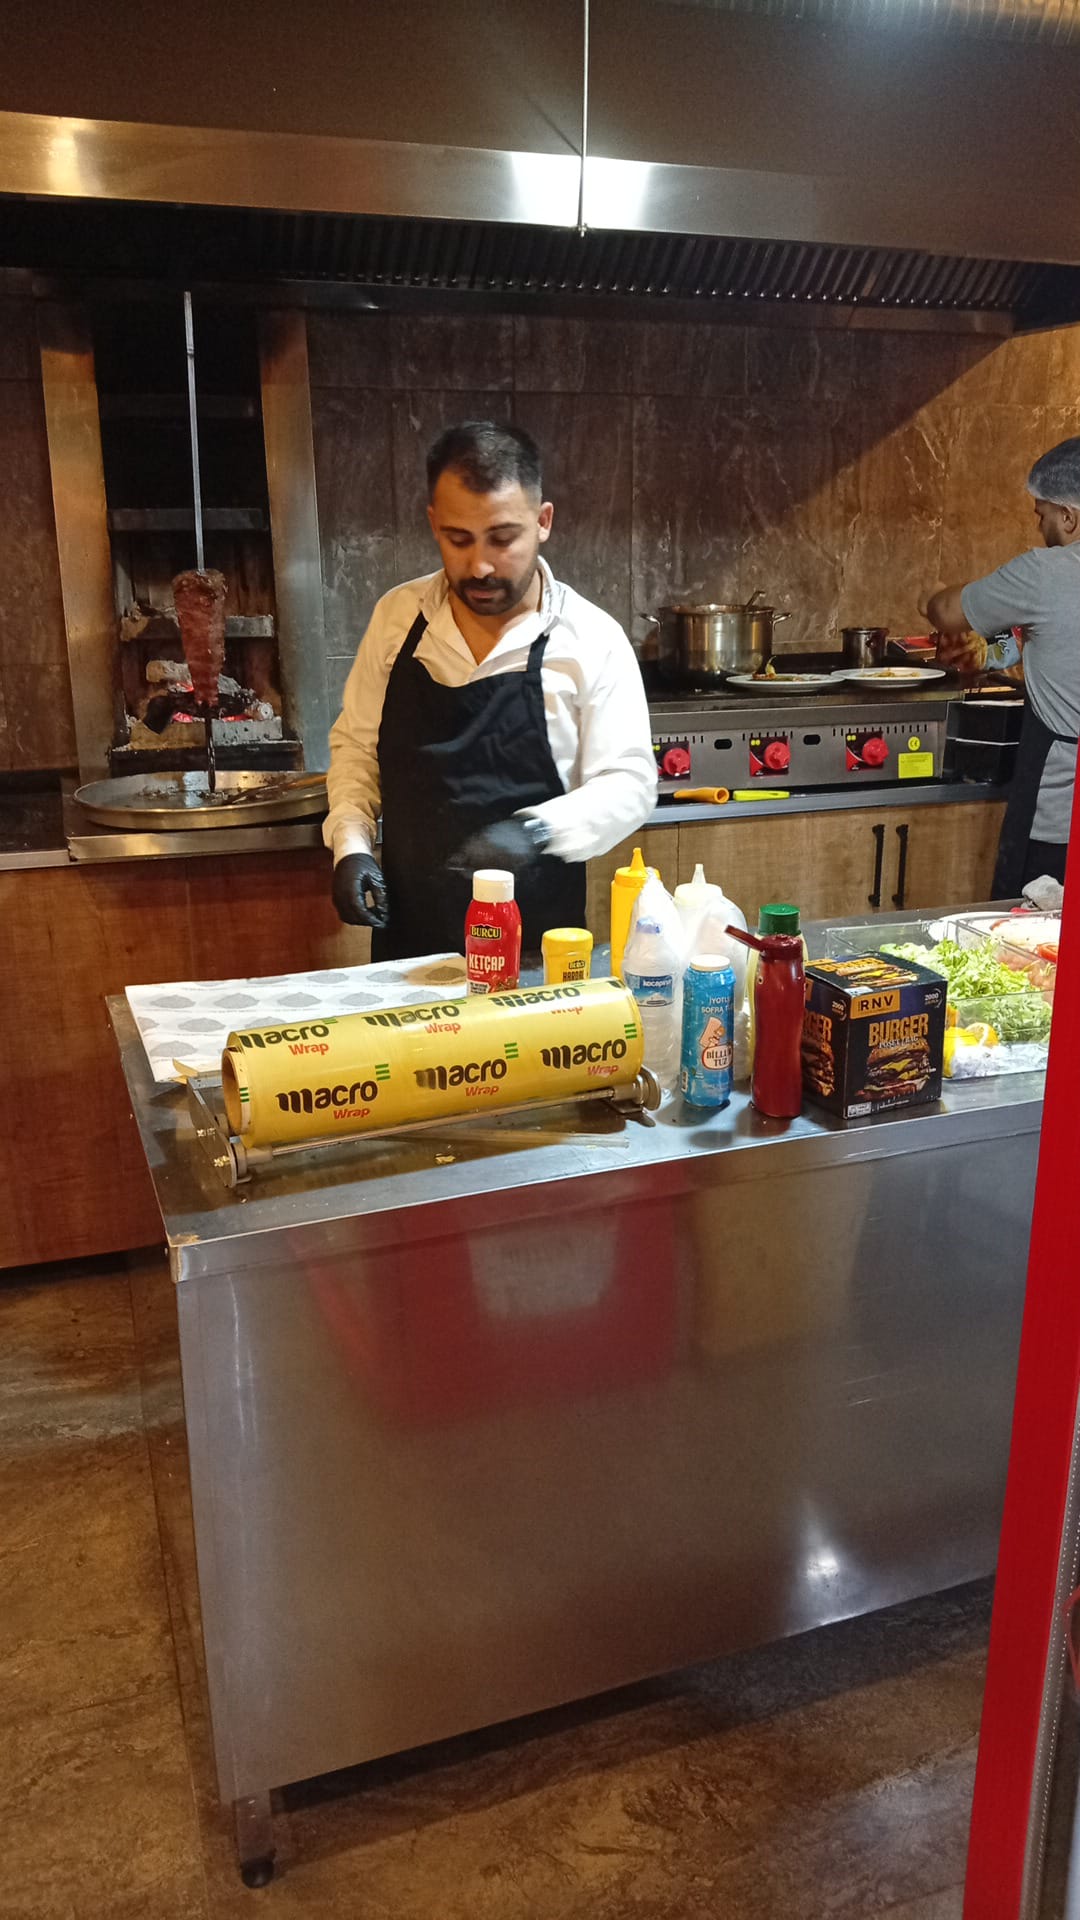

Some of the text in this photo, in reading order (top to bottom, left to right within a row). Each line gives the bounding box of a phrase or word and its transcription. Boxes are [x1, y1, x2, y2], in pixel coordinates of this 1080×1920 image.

[472, 926, 499, 938] BURCU
[469, 953, 505, 973] KETÇAP
[487, 987, 581, 1008] macro
[861, 995, 893, 1011] RNV
[361, 1004, 460, 1027] macro
[425, 1022, 461, 1035] Wrap
[868, 1013, 929, 1047] BURGER
[288, 1042, 330, 1056] Wrap
[540, 1038, 627, 1070] macro
[412, 1058, 507, 1091] macro
[587, 1064, 619, 1076] Wrap
[275, 1080, 378, 1114] macro
[465, 1085, 499, 1097] Wrap
[333, 1107, 371, 1120] Wrap
